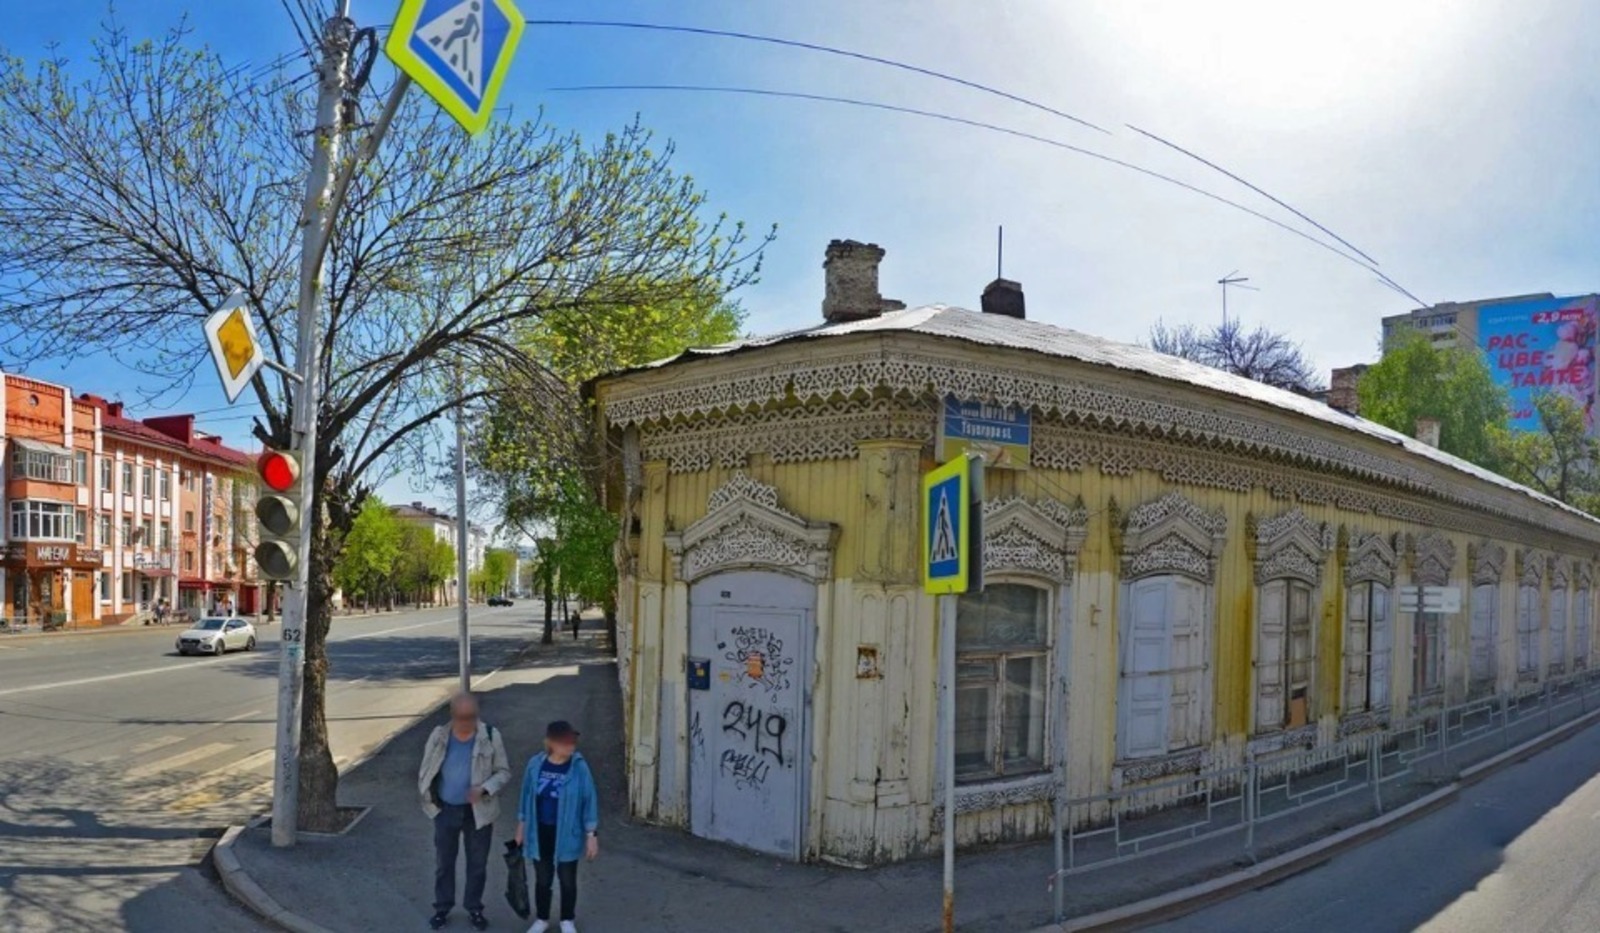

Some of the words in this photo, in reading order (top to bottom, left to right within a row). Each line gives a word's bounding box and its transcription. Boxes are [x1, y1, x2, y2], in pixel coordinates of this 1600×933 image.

[1488, 333, 1539, 350] РАС-
[1498, 350, 1554, 370] ЦВЕ-
[1512, 365, 1586, 387] ТАЙТЕ
[283, 628, 301, 642] 62
